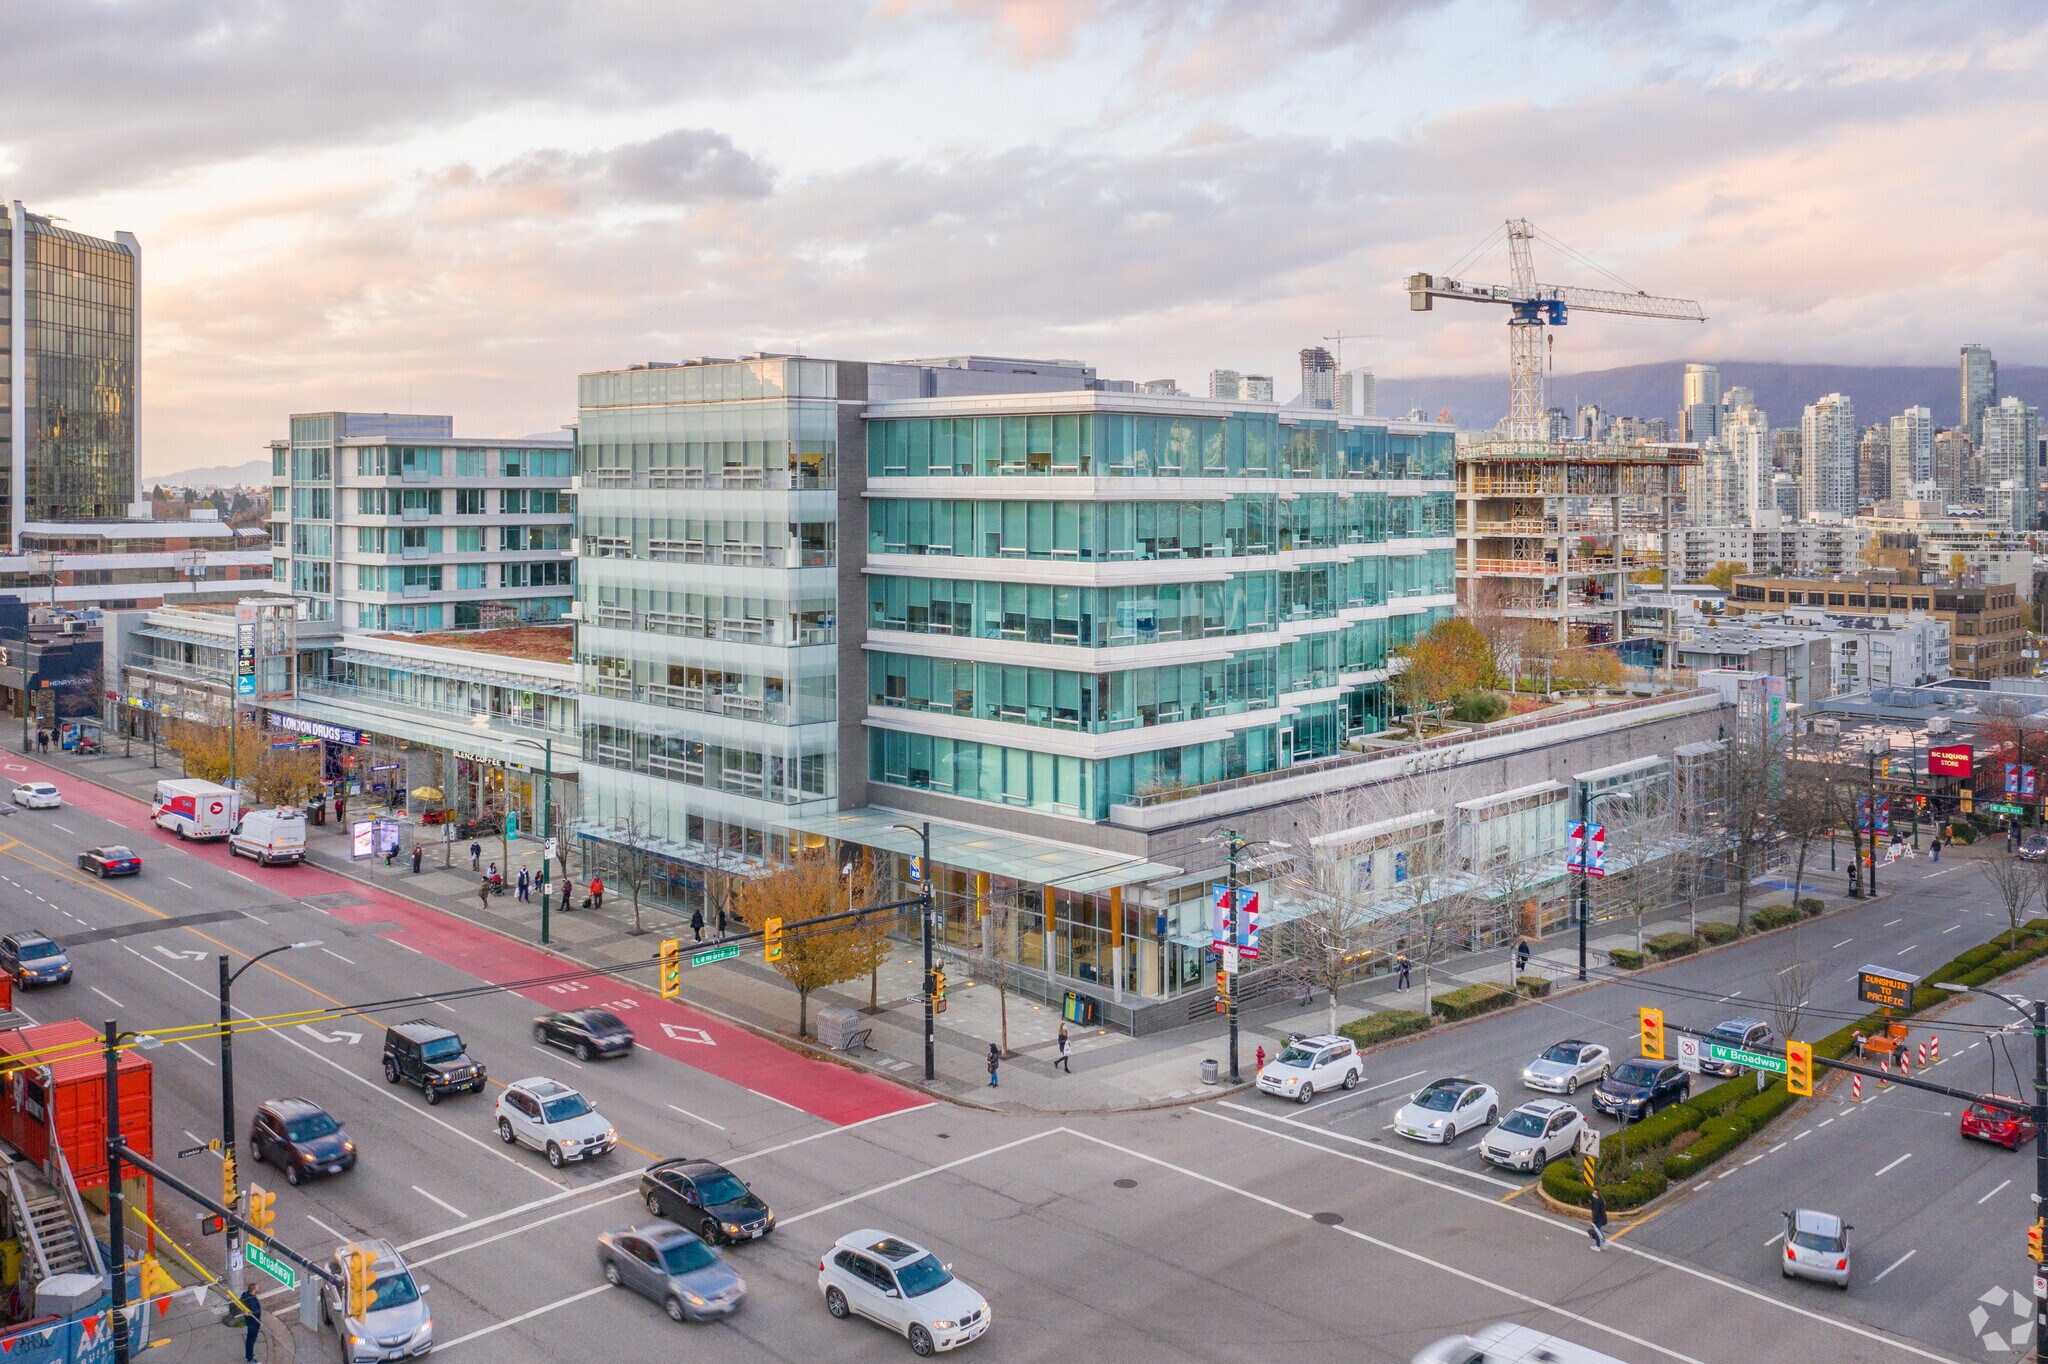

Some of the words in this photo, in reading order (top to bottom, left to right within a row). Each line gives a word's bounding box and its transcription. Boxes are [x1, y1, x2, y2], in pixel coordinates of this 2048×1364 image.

[1494, 289, 1508, 298] BIRD
[282, 716, 312, 734] LONDON
[312, 723, 341, 741] DRUGS
[453, 749, 475, 761] BLENZ
[475, 755, 501, 767] COFFEE
[1942, 752, 1969, 761] LIQUOR
[911, 871, 920, 879] RB
[1205, 953, 1219, 962] RBC
[547, 981, 589, 994] BUS
[1865, 974, 1908, 991] DUNSMUIR
[1880, 987, 1892, 996] TO
[590, 998, 641, 1012] TOP
[1866, 991, 1904, 1007] PACIFIC
[1716, 1047, 1727, 1057] W
[1730, 1050, 1781, 1070] Broadway
[250, 1246, 257, 1259] W
[259, 1251, 291, 1283] Broadway
